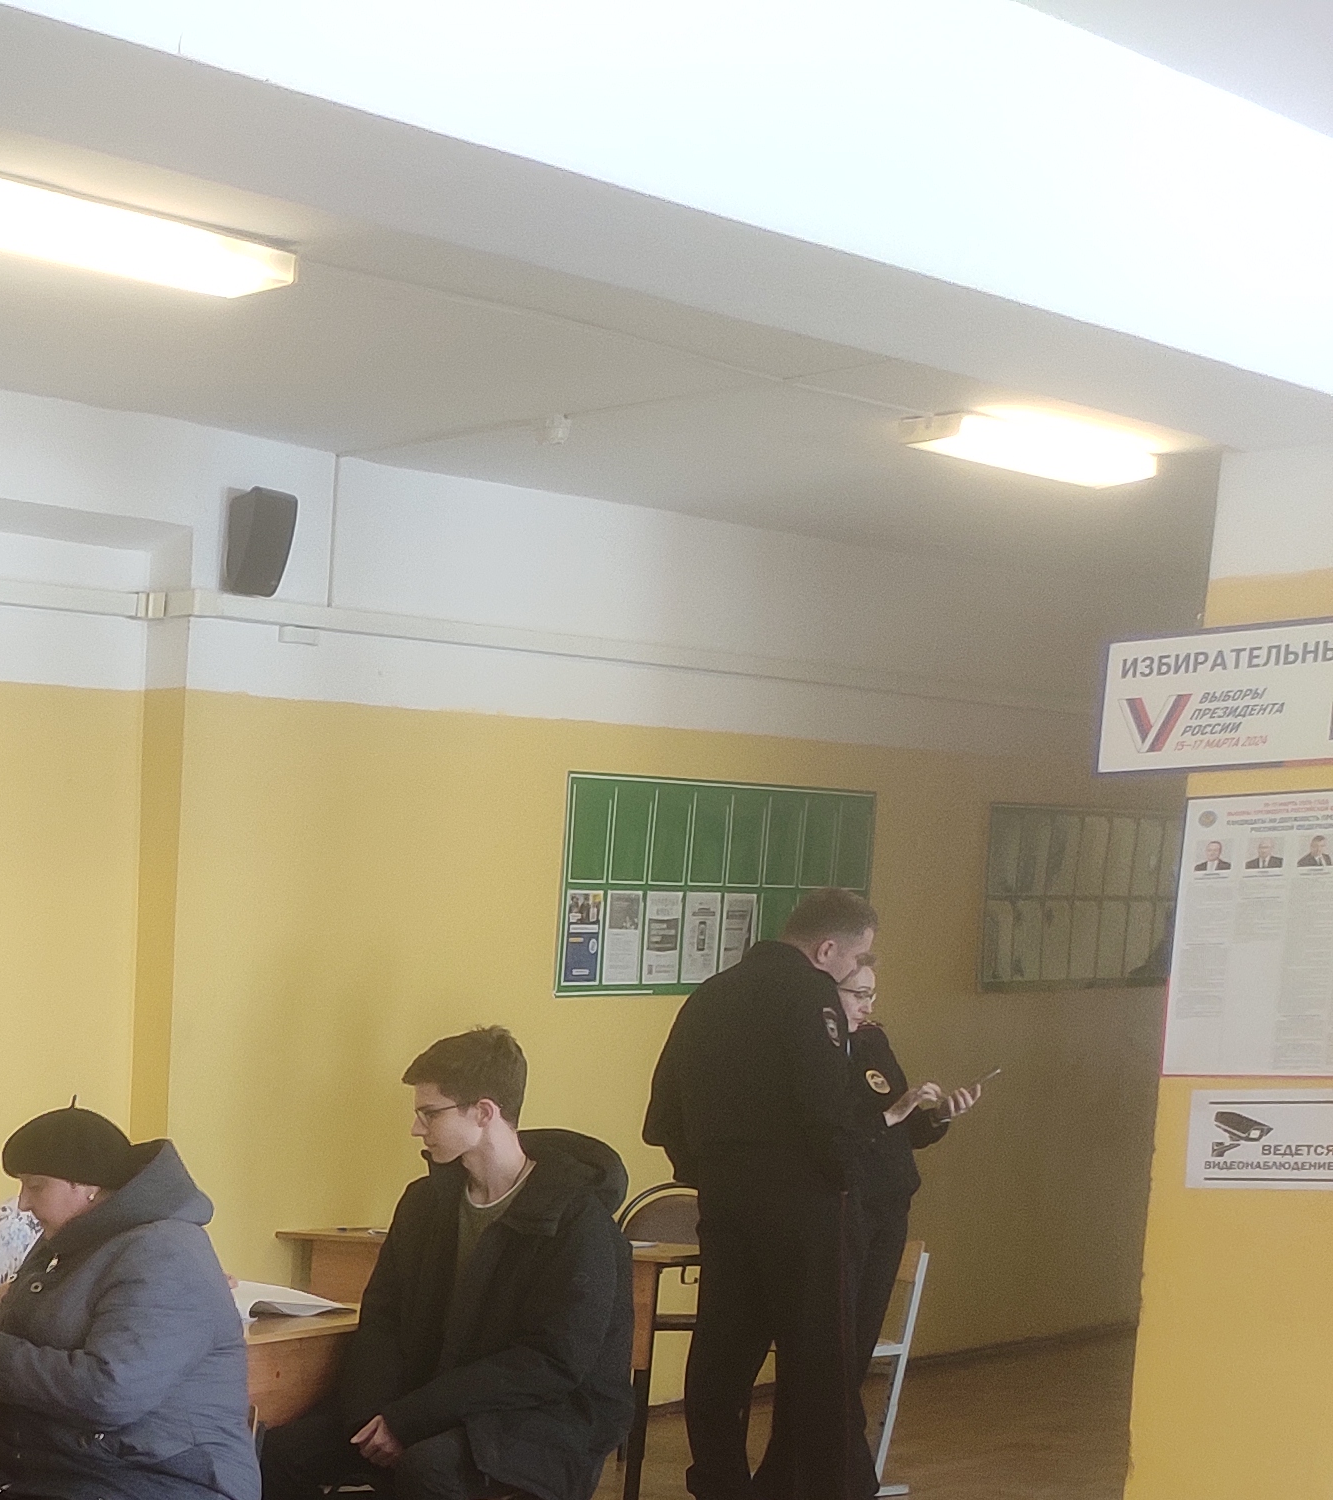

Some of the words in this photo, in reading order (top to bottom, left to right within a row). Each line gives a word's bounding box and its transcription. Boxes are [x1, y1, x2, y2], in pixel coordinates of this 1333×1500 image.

[1199, 687, 1268, 704] ВЫБОРЫ
[1190, 702, 1286, 720] ПРЕЗИДЕНТА
[1181, 721, 1242, 737] РОССИИ
[1204, 737, 1240, 750] МАРТА
[1241, 735, 1268, 747] 2024
[1261, 1144, 1333, 1157] ВЕДЕТСЯ
[1204, 1160, 1333, 1171] ВИДЕОНАБЛЮДЕНИЕ
